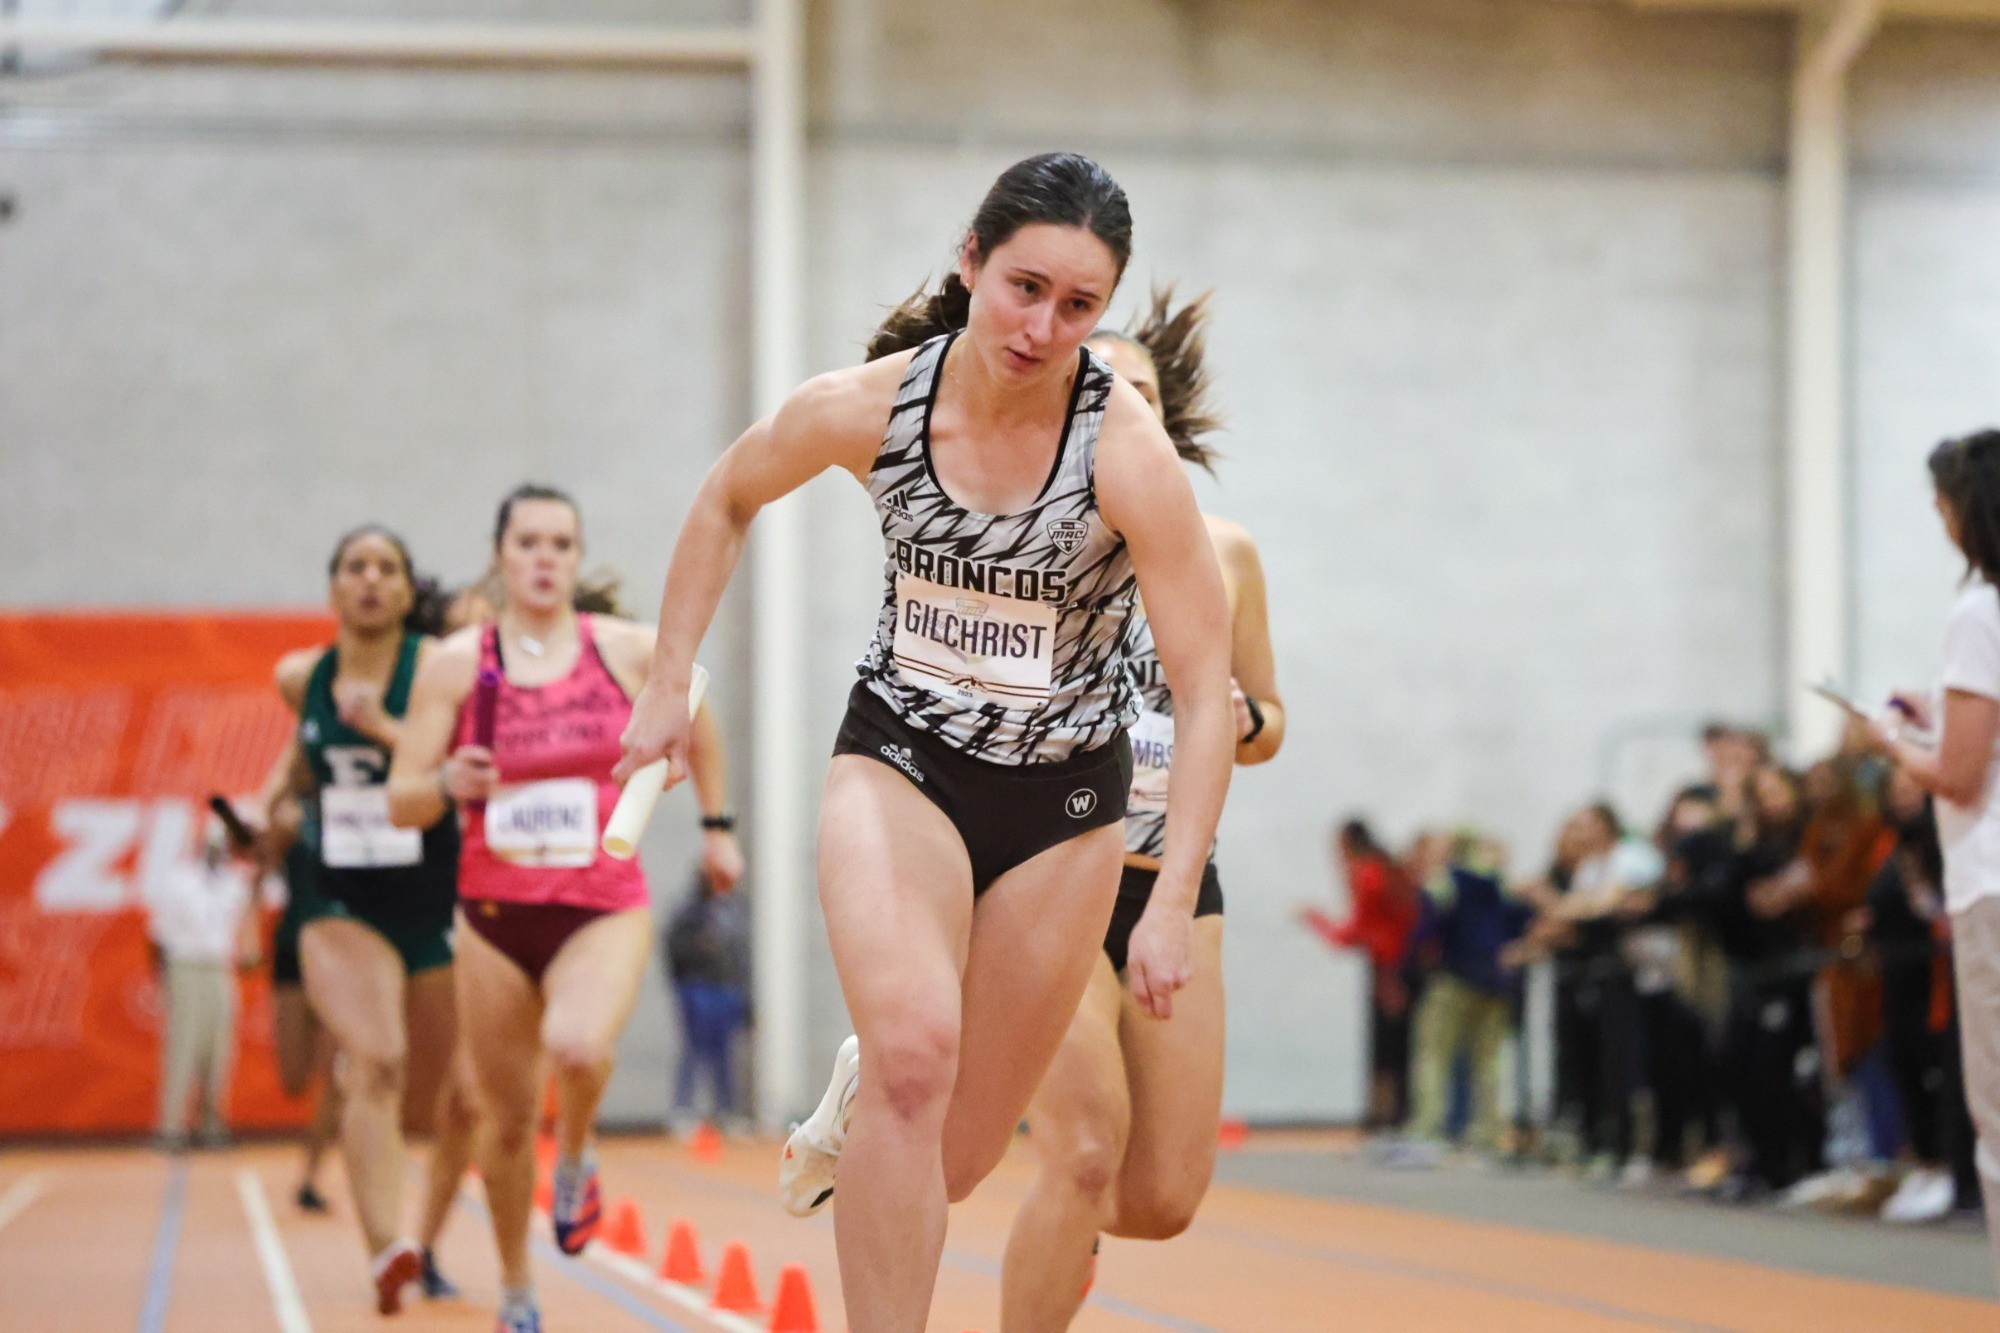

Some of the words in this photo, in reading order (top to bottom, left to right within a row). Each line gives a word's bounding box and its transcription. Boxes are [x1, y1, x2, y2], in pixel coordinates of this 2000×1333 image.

[1051, 530, 1084, 539] MAC
[896, 539, 1069, 602] BRONCOS
[905, 599, 1048, 659] GILCHRIST
[880, 745, 925, 783] adidas
[1071, 794, 1091, 813] W
